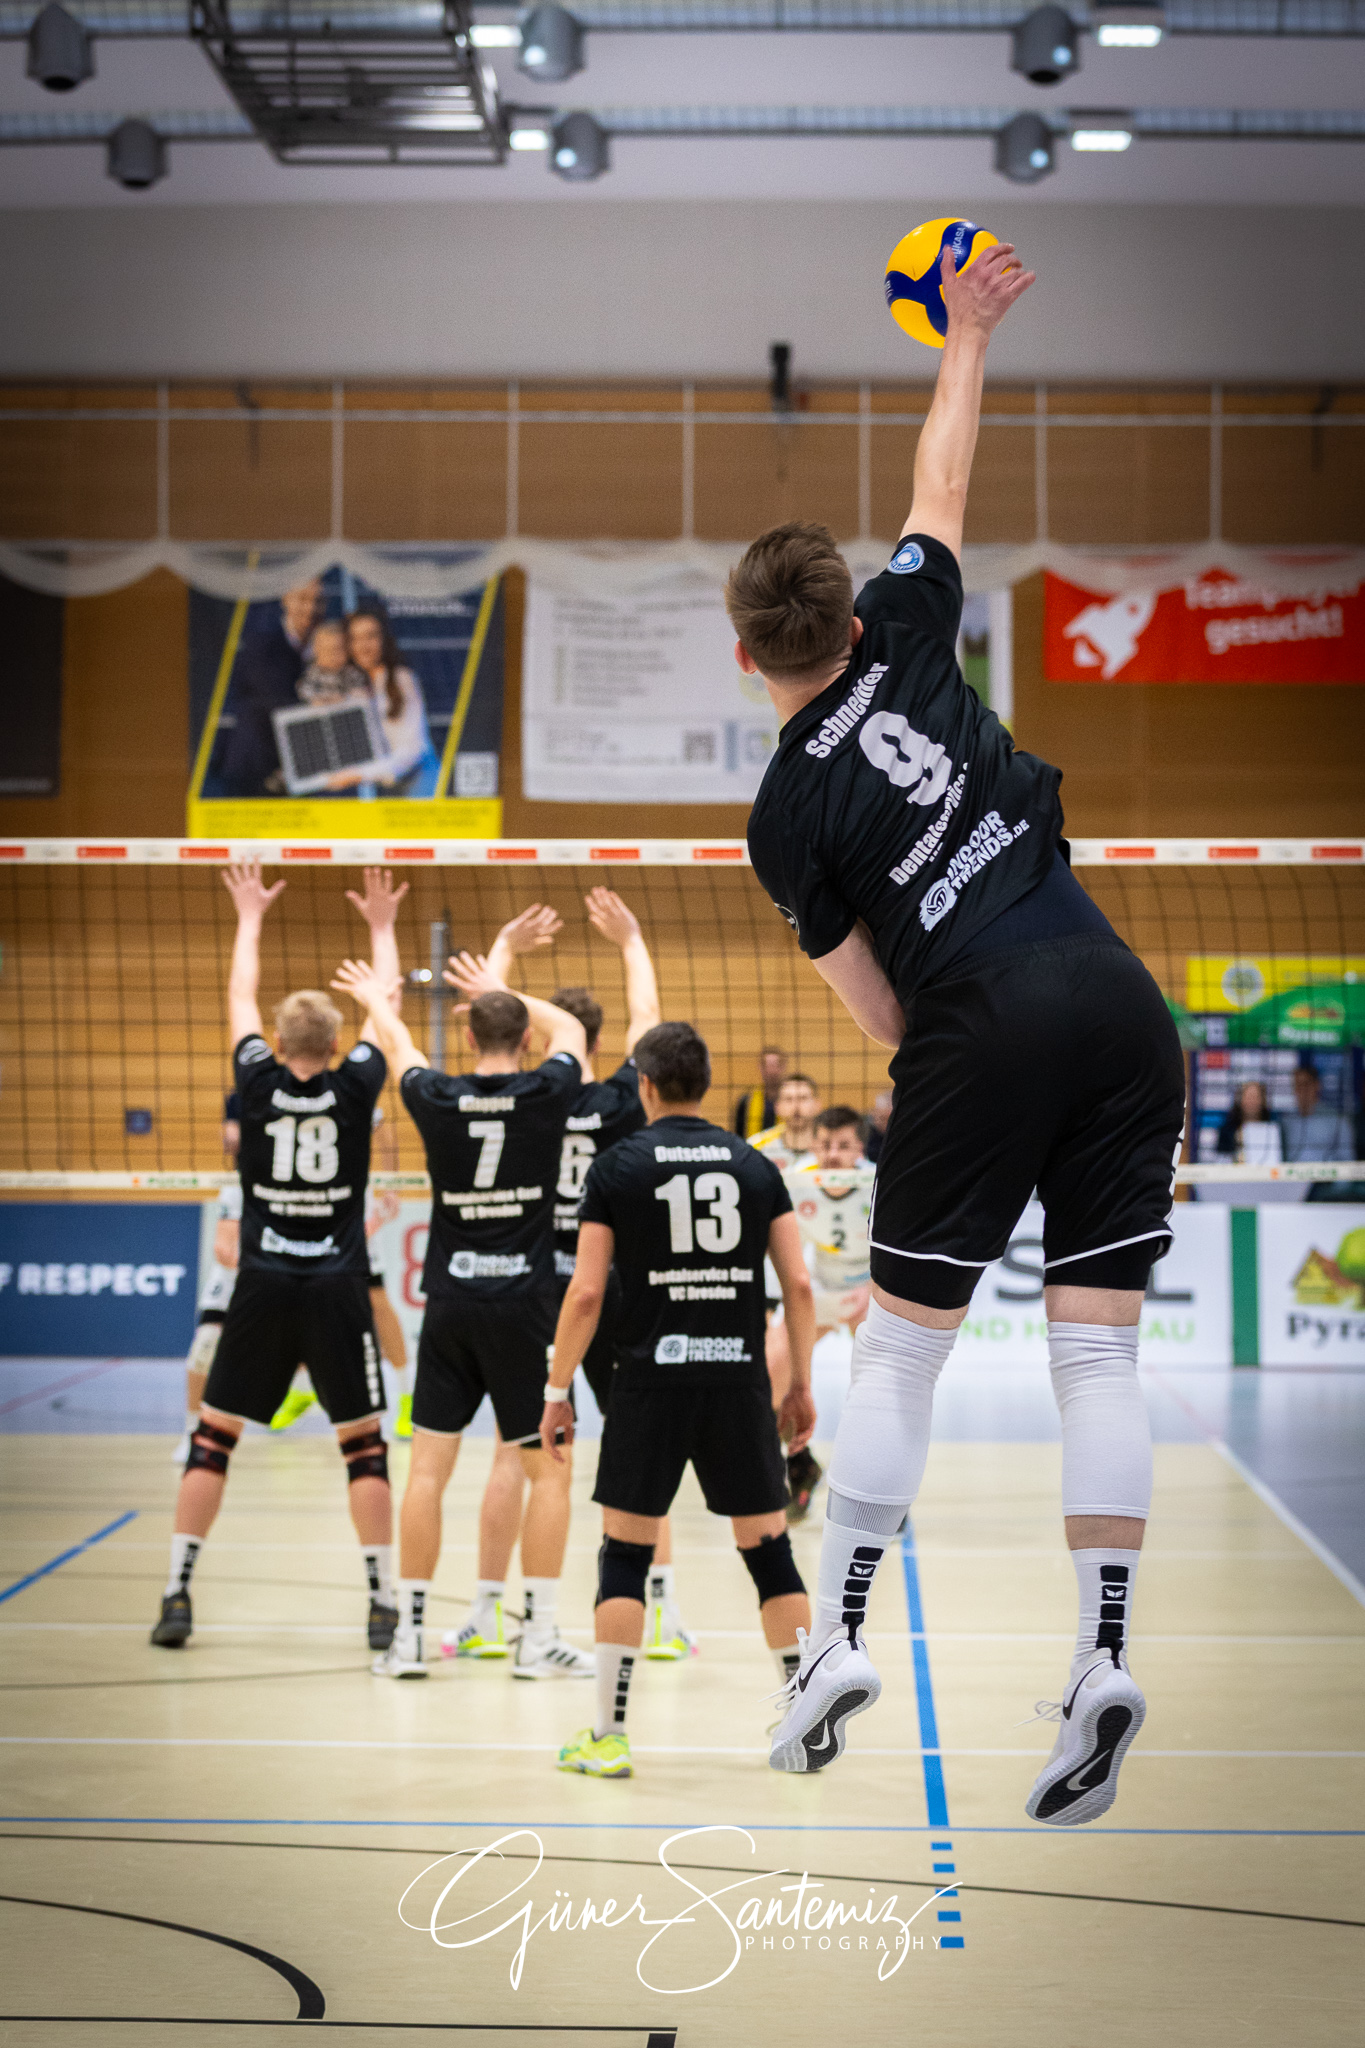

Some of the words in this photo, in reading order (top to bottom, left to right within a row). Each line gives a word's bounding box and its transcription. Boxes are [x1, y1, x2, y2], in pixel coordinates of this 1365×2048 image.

[1205, 602, 1343, 655] gesucht!
[805, 662, 889, 758] Schneider
[859, 711, 952, 806] 9
[946, 811, 1005, 880] INDOOR
[264, 1115, 339, 1183] 18
[468, 1120, 505, 1188] 7
[556, 1134, 597, 1198] 6
[655, 1172, 742, 1253] 13
[17, 1262, 187, 1296] RESPECT
[689, 1337, 745, 1351] INDOOR
